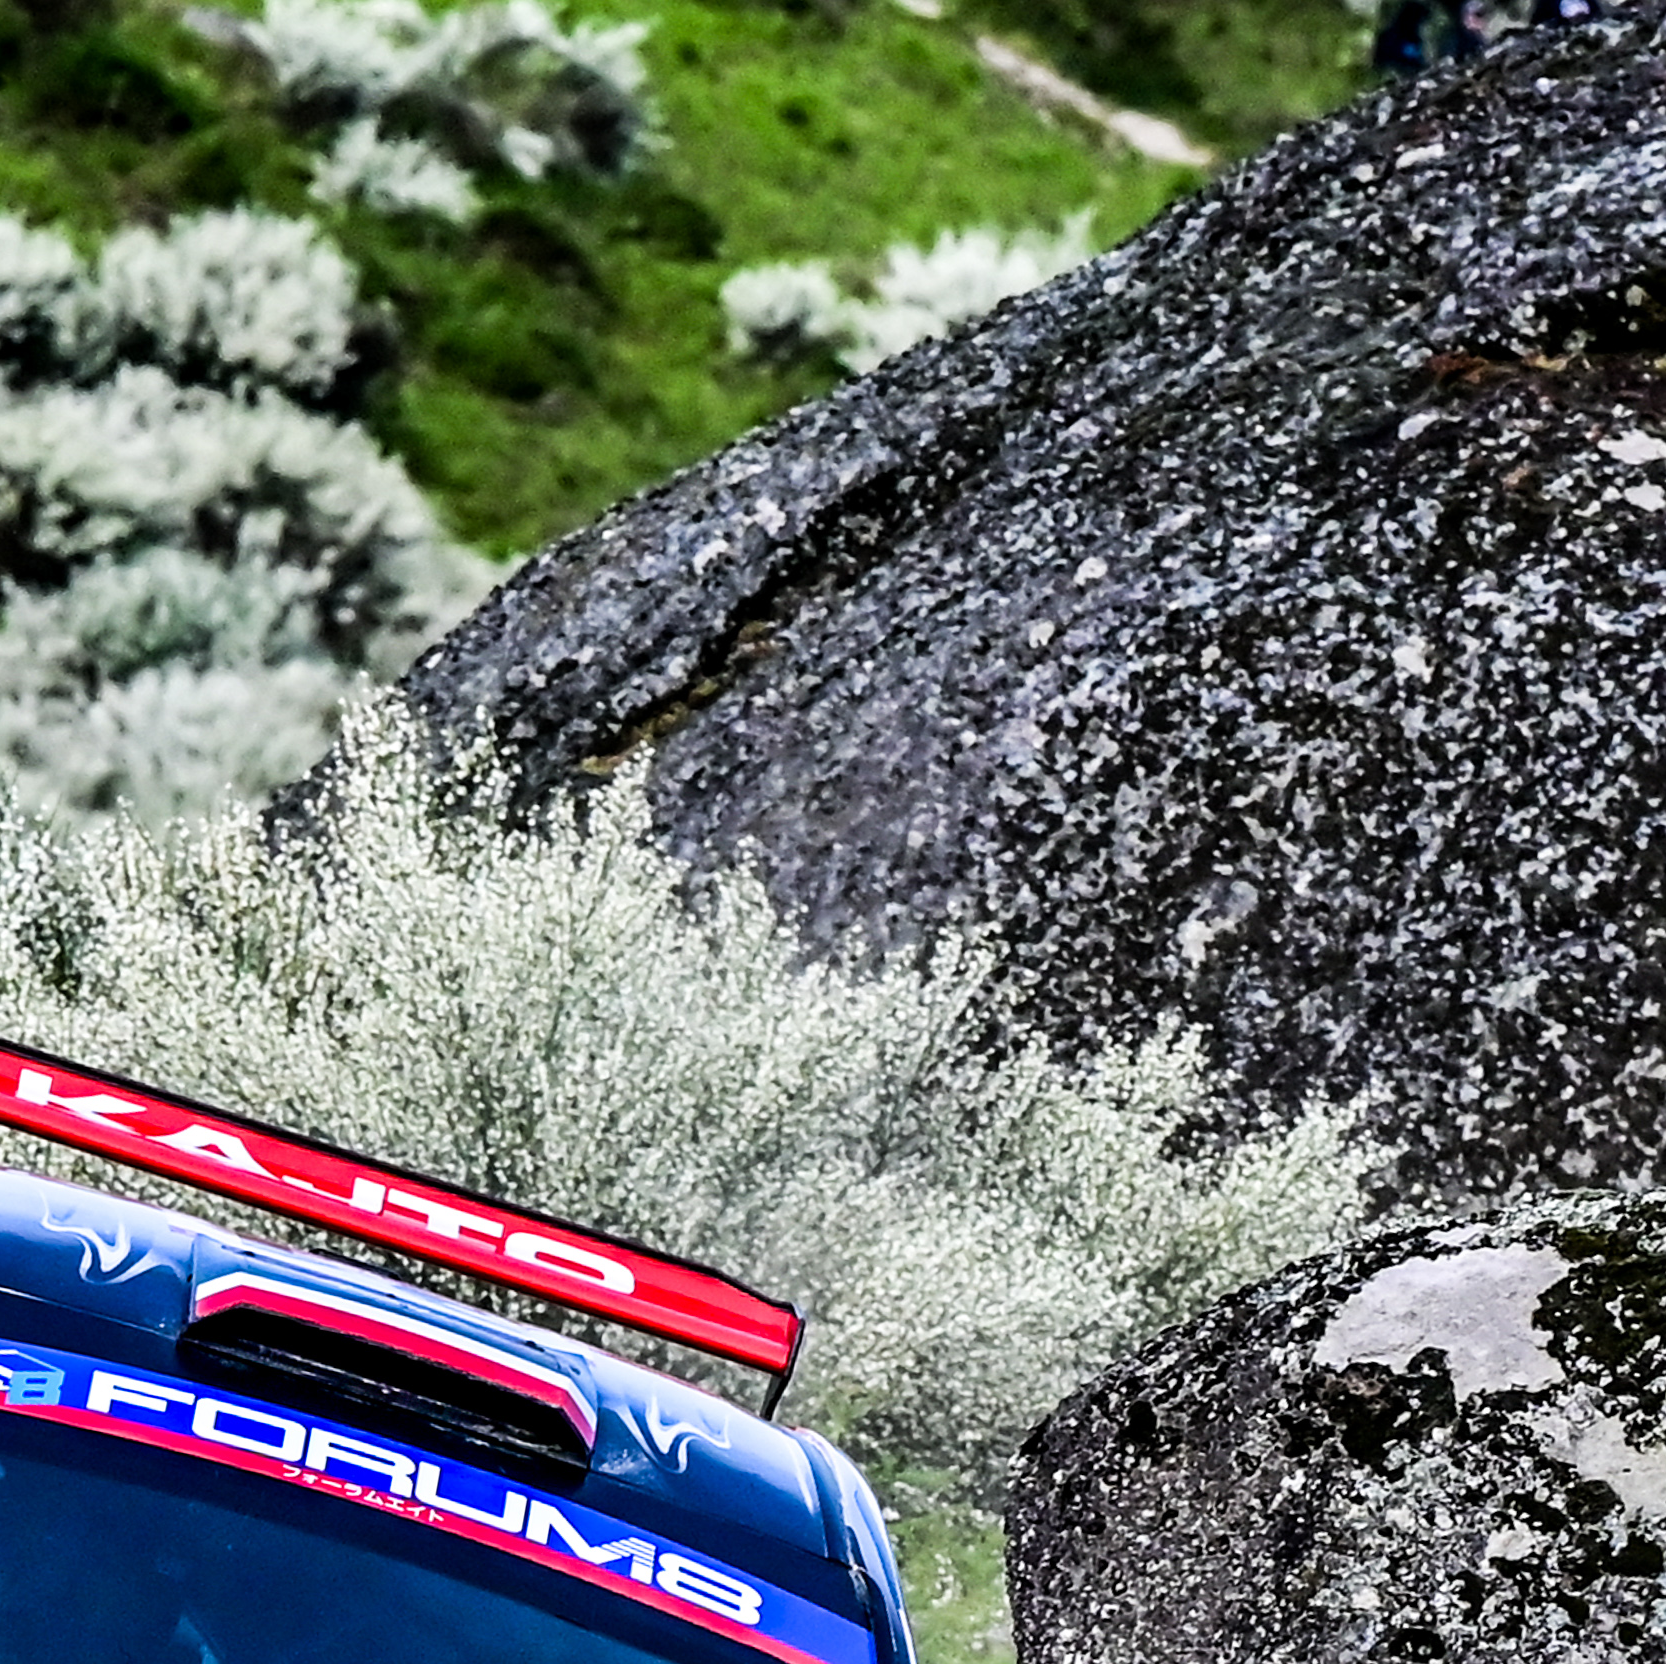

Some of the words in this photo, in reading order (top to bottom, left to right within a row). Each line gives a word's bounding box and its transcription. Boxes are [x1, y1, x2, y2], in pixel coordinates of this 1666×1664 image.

[15, 1068, 635, 1295] KAJTO
[85, 1369, 763, 1626] FORUM8
[282, 1464, 444, 1522] フォーラムエイト
